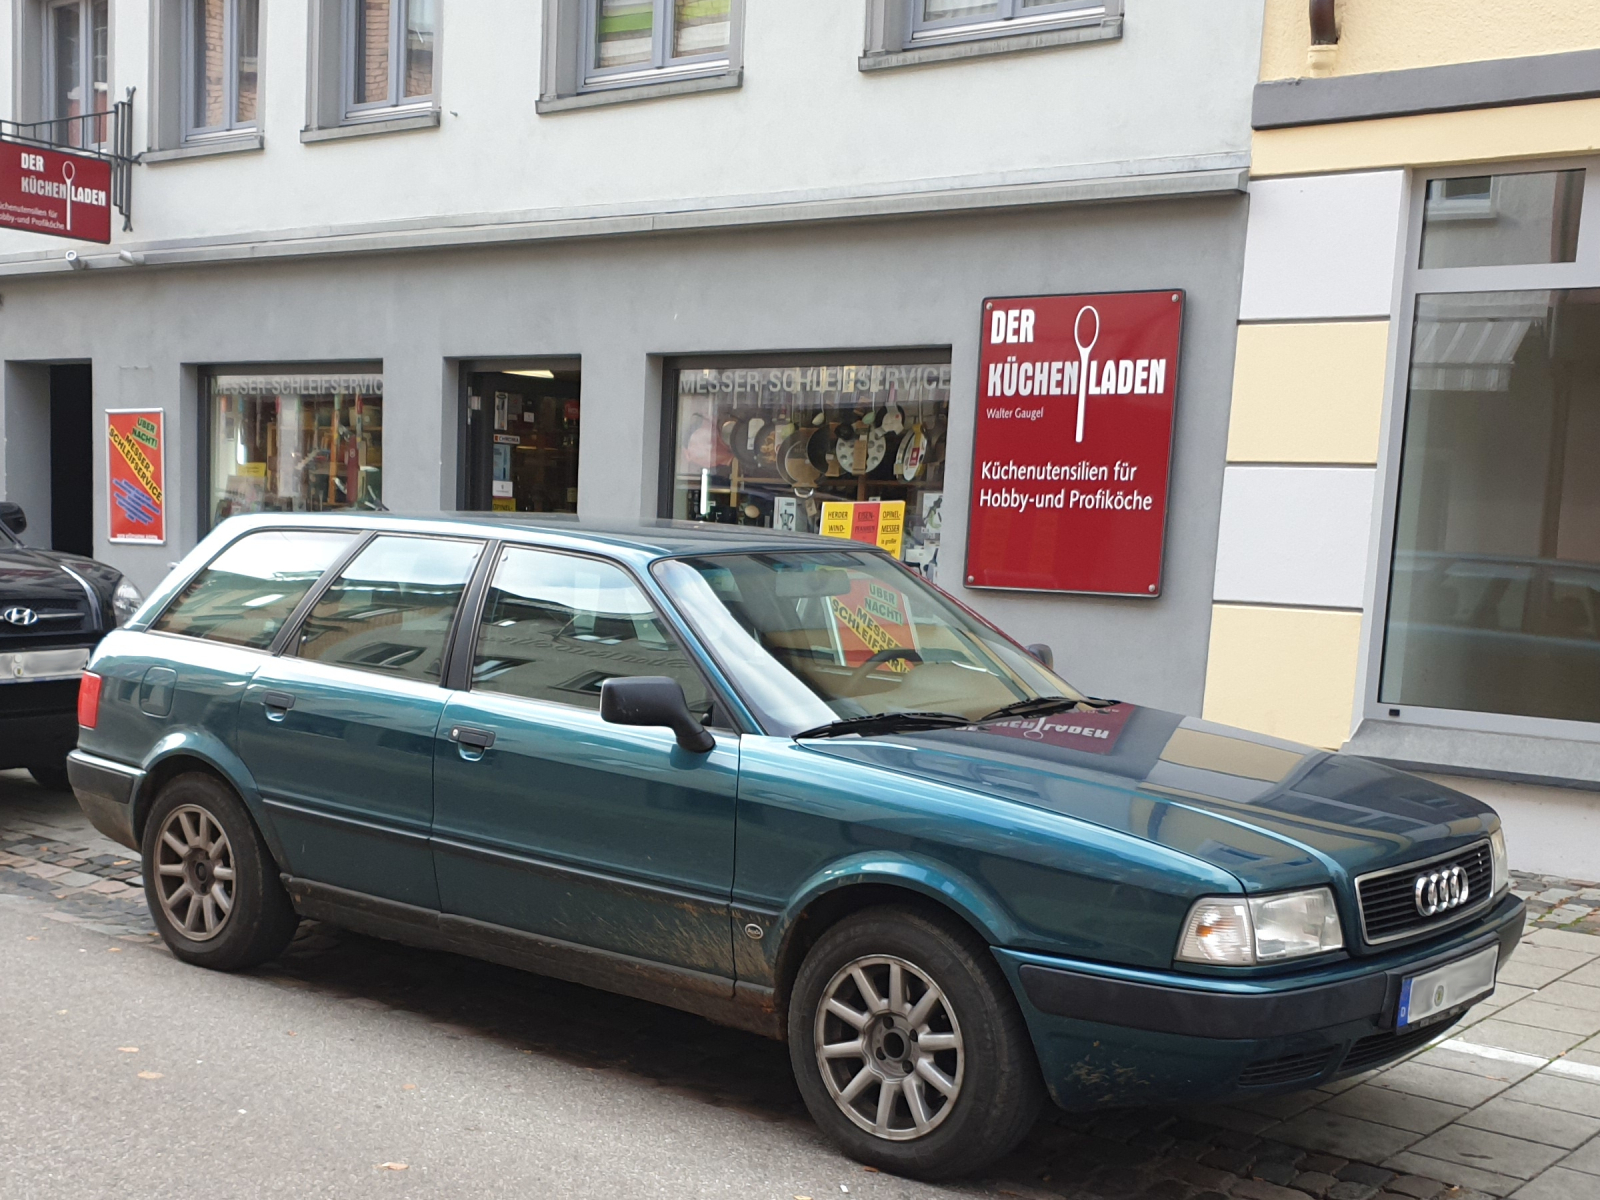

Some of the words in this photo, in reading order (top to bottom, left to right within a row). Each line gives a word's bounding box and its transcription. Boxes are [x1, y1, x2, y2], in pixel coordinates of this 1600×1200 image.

[21, 152, 44, 172] DER
[21, 175, 67, 199] KÜCHEN
[71, 185, 106, 206] LADEN
[991, 309, 1035, 344] DER
[987, 356, 1079, 397] KÜCHEN
[1088, 359, 1166, 395] LADEN
[986, 408, 1013, 419] Walter
[1014, 407, 1044, 421] Gaugel
[109, 427, 162, 502] SCHLEIFSERVICE
[126, 434, 152, 474] MESSER-
[981, 460, 1108, 481] Küchenutensilien
[1113, 460, 1138, 481] für
[979, 488, 1066, 513] Hobby-und
[1069, 489, 1153, 511] Profiköche
[828, 511, 848, 519] HERDER
[881, 525, 900, 533] MESSER
